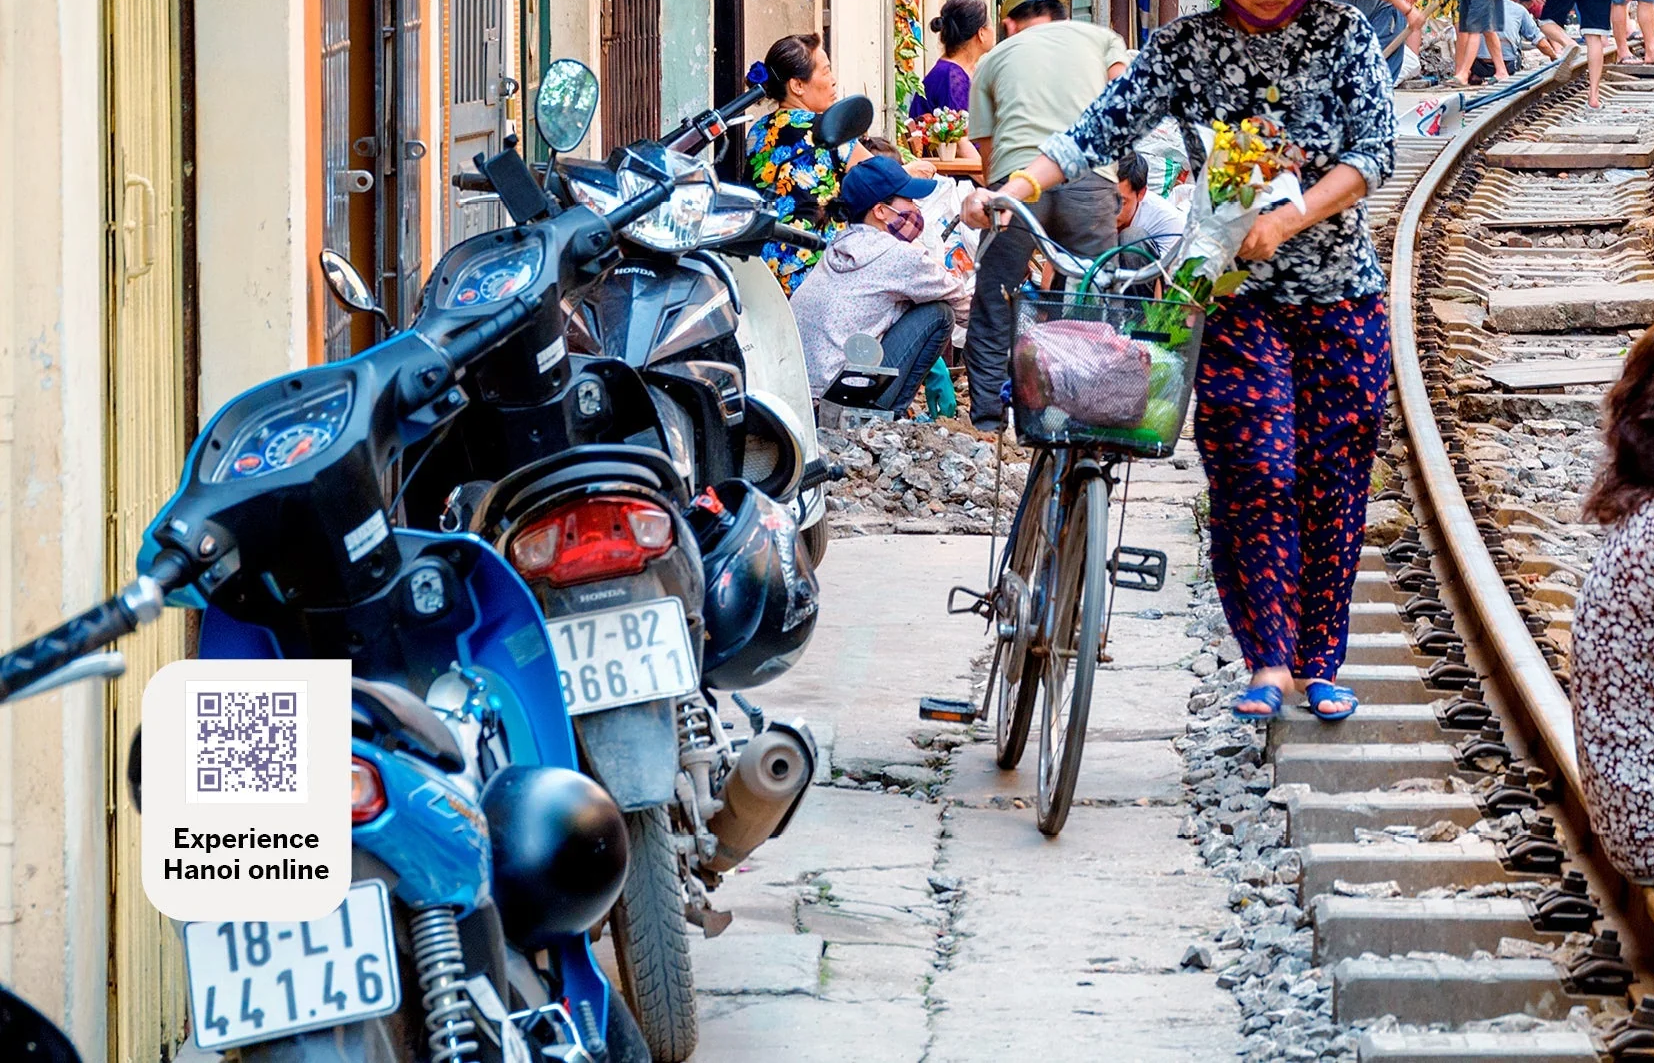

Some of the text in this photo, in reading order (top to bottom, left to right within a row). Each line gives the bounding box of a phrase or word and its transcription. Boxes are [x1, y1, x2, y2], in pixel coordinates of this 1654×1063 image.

[613, 267, 657, 278] HONDA
[579, 588, 626, 603] HONDA
[559, 609, 666, 662] 17-B2
[217, 897, 354, 973] 18-L1
[204, 953, 384, 1037] 441.46
